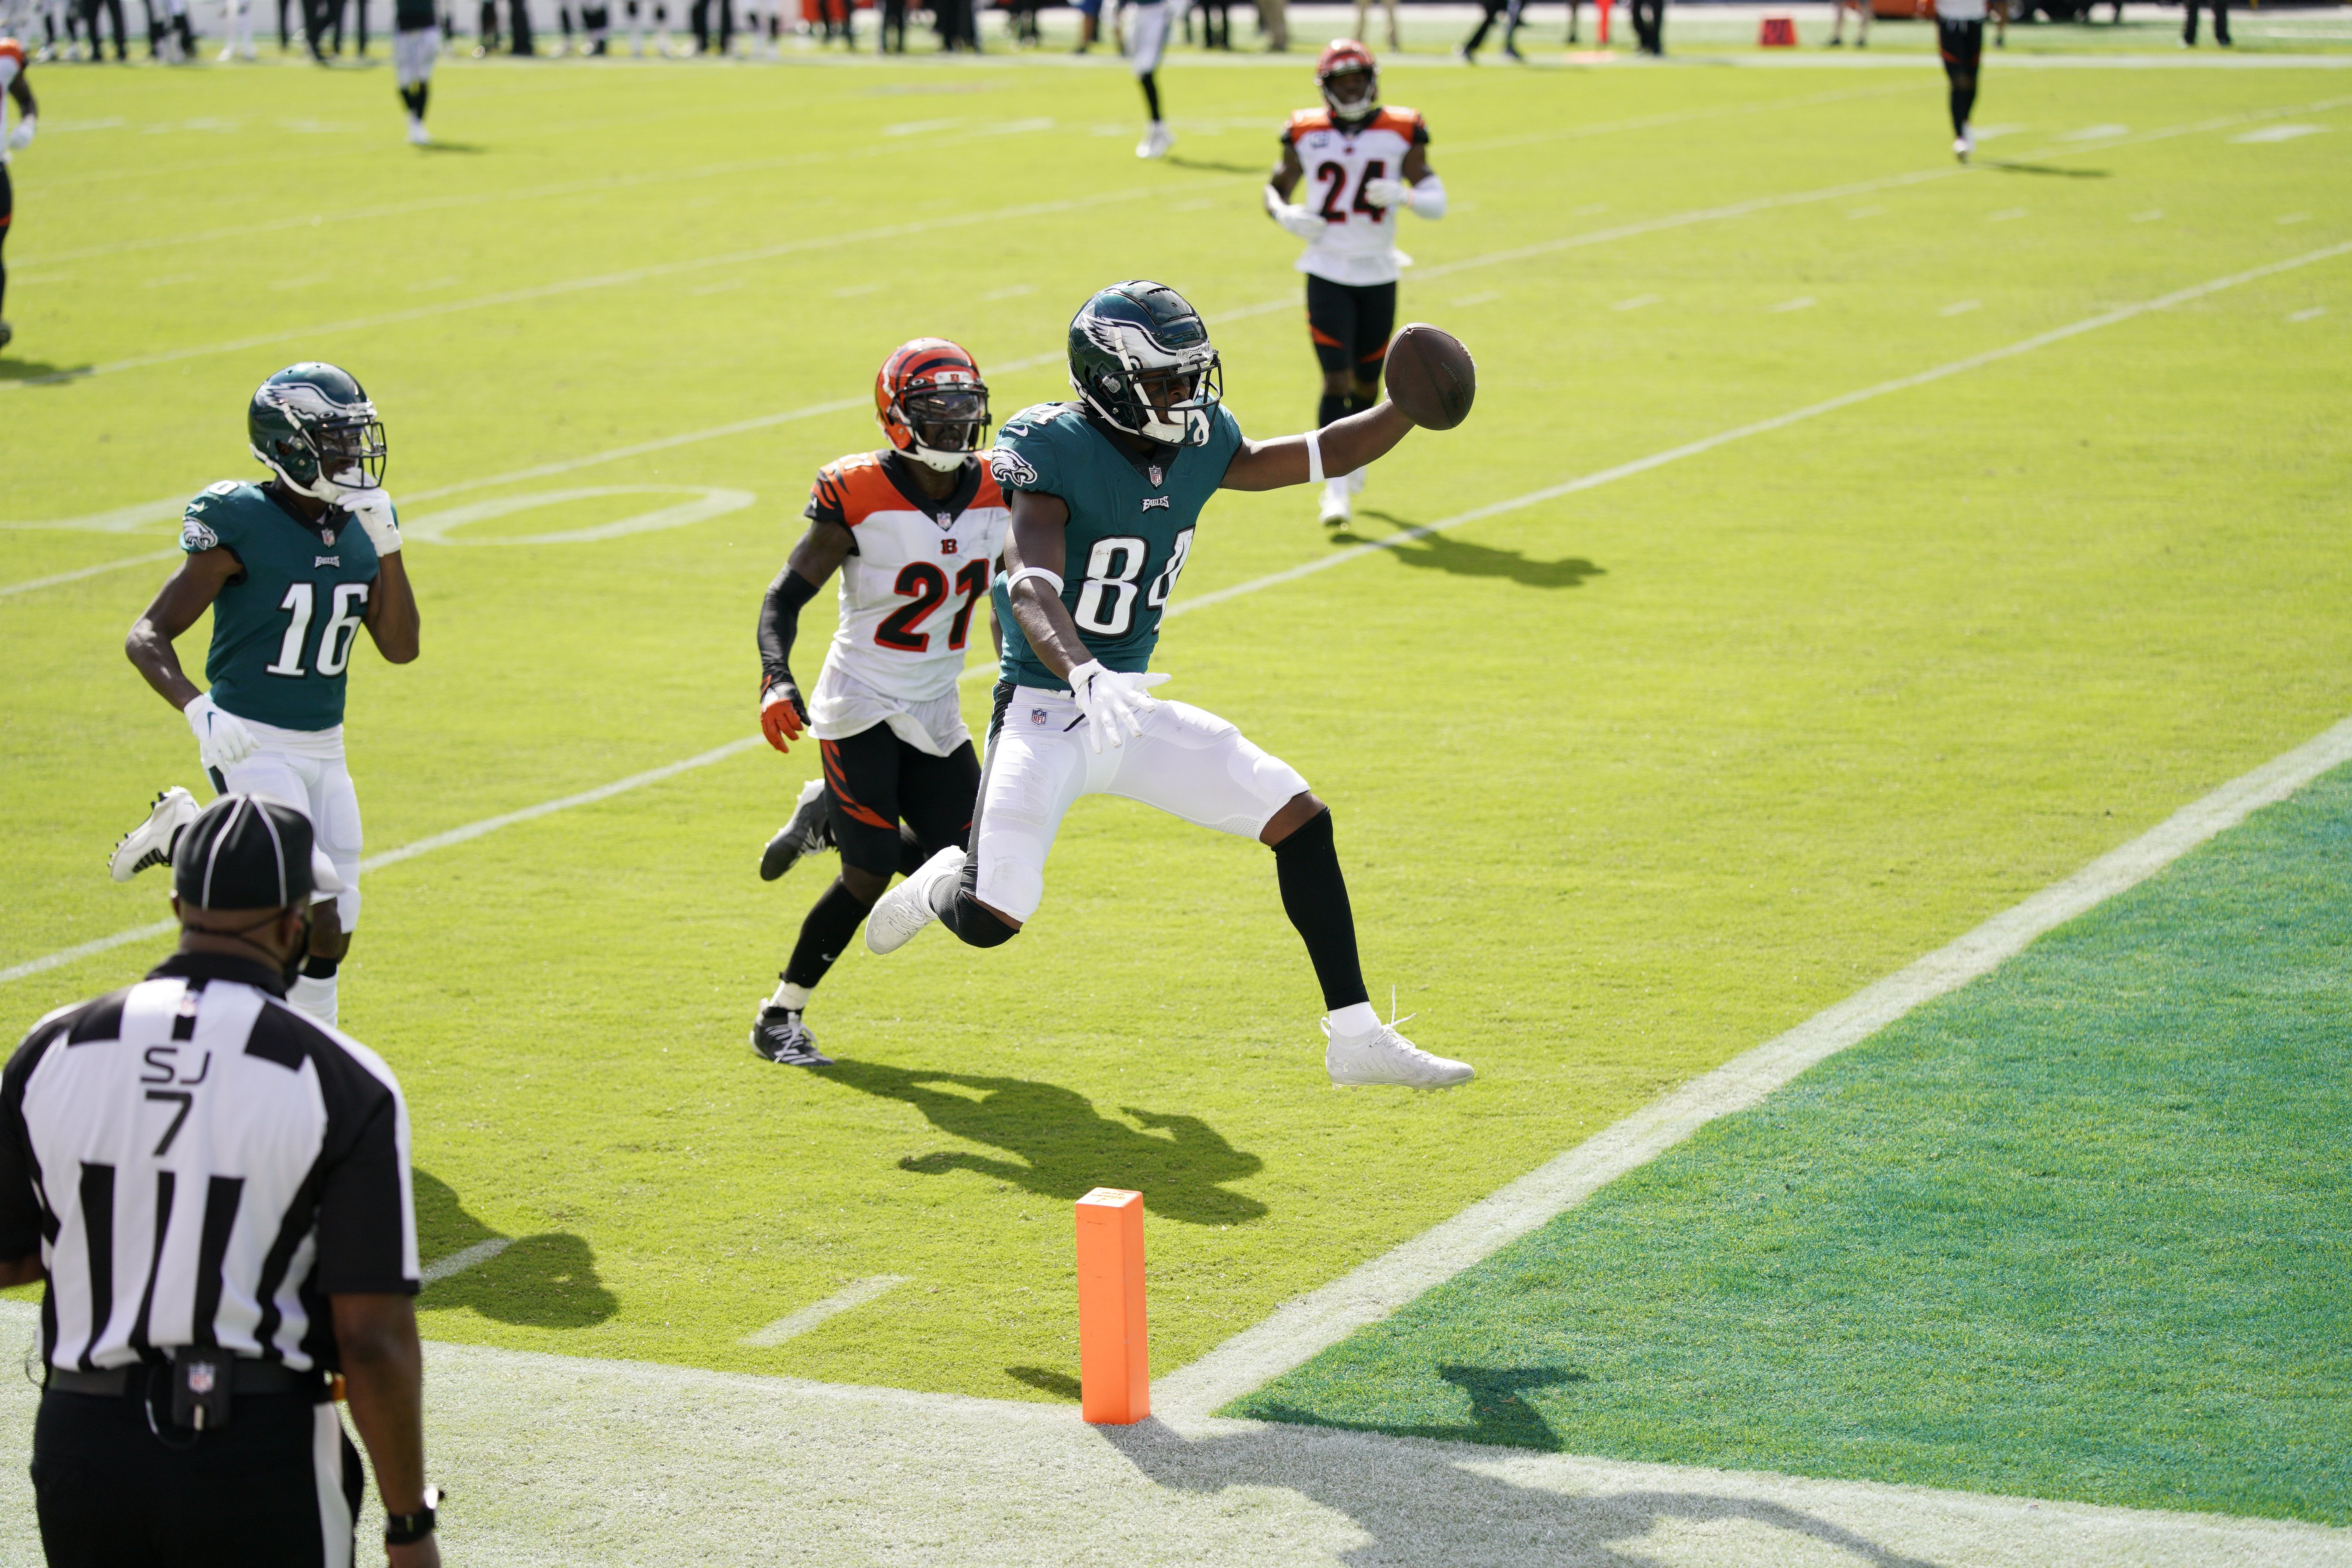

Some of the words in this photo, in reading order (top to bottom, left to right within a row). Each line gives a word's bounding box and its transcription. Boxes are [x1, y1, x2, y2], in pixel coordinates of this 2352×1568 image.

[1318, 161, 1385, 222] 24
[1441, 361, 1458, 384] NATIONAL
[1152, 474, 1161, 483] NFL
[1140, 495, 1170, 513] EAGLES
[874, 558, 989, 652] 21
[1073, 524, 1196, 640] 84
[264, 580, 369, 679] 16
[1033, 715, 1044, 723] NFL
[141, 1046, 210, 1084] SJ
[144, 1090, 192, 1157] 7
